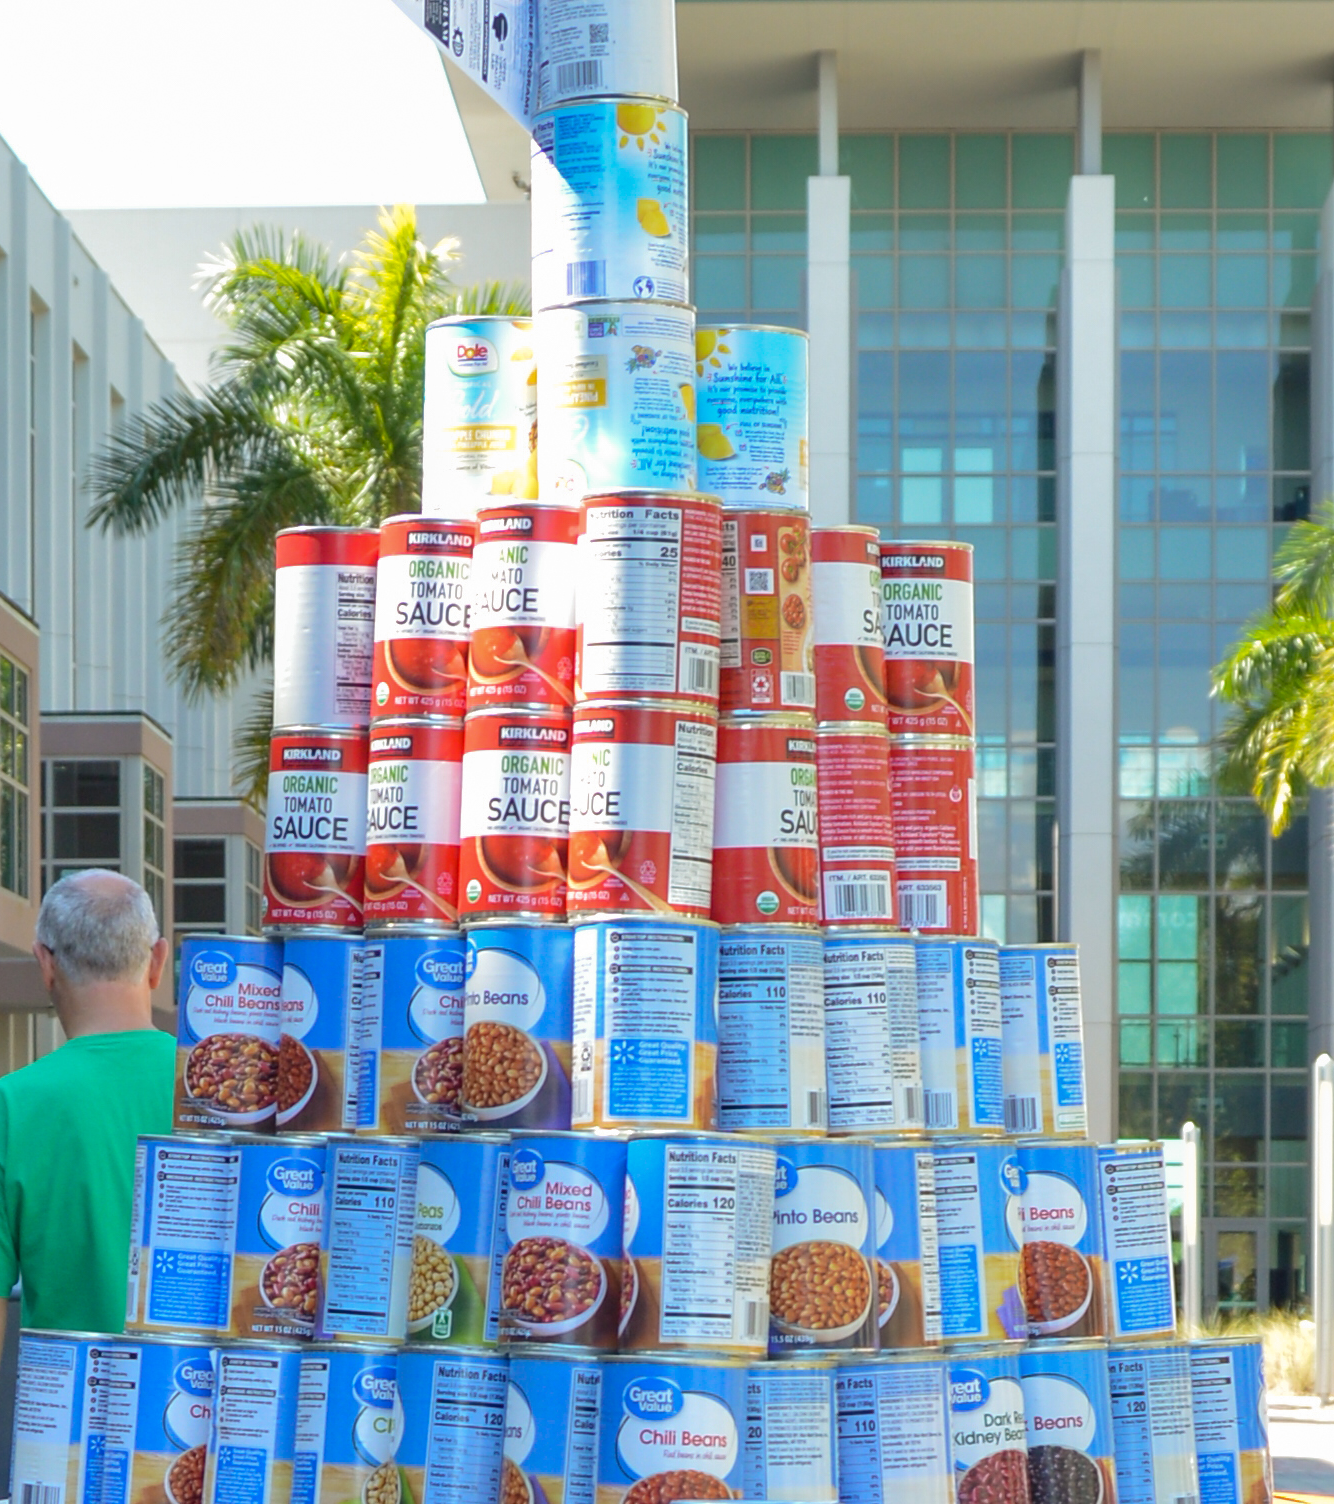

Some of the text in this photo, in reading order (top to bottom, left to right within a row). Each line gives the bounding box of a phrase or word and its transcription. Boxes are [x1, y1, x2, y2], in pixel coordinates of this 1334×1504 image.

[458, 344, 487, 359] Dole
[714, 373, 752, 383] Sunshine
[756, 373, 766, 383] for
[718, 406, 737, 418] good
[645, 509, 679, 521] Facts
[409, 533, 472, 547] KIRKLAND
[660, 546, 678, 558] 25
[409, 560, 469, 578] ORGANIC
[882, 555, 944, 569] KIRKLAND
[411, 582, 463, 599] TOMATO
[883, 583, 942, 601] ORGANIC
[886, 604, 939, 620] TOMATO
[501, 728, 566, 741] KIRKLAND
[678, 724, 714, 736] Nutrition
[283, 749, 341, 761] KIRKLAND
[501, 754, 564, 776] ORGANIC
[677, 763, 708, 775] Calories
[283, 776, 338, 794] ORGANIC
[503, 777, 558, 795] TOMATO
[284, 797, 332, 813] TOMATO
[487, 798, 570, 824] SAUCE
[273, 817, 349, 841] SAUCE
[760, 945, 785, 957] Facts
[195, 960, 227, 974] Great
[423, 959, 465, 974] Great
[201, 973, 227, 982] Value
[432, 971, 464, 983] Value
[238, 983, 281, 997] Mixed
[720, 986, 786, 999] Calories 110
[205, 995, 280, 1011] Chili Beans
[483, 991, 529, 1006] Beans
[339, 1153, 398, 1167] Nutrition Facts
[668, 1152, 737, 1164] Nutrition Facts
[274, 1166, 315, 1183] Great
[282, 1180, 314, 1192] Value
[546, 1182, 593, 1196] Mixed
[335, 1197, 395, 1210] Calories 110
[517, 1196, 591, 1211] Chili Beans
[668, 1196, 735, 1210] Calories 120
[812, 1209, 860, 1225] Beans
[1029, 1204, 1075, 1221] Beans
[438, 1366, 507, 1383] Nutrition Facts
[629, 1386, 673, 1402] Great
[639, 1401, 672, 1412] Value
[435, 1411, 504, 1427] Calories 120
[984, 1413, 1011, 1427] Dark
[1034, 1416, 1083, 1431] Beans
[639, 1429, 727, 1447] Chili Beans
